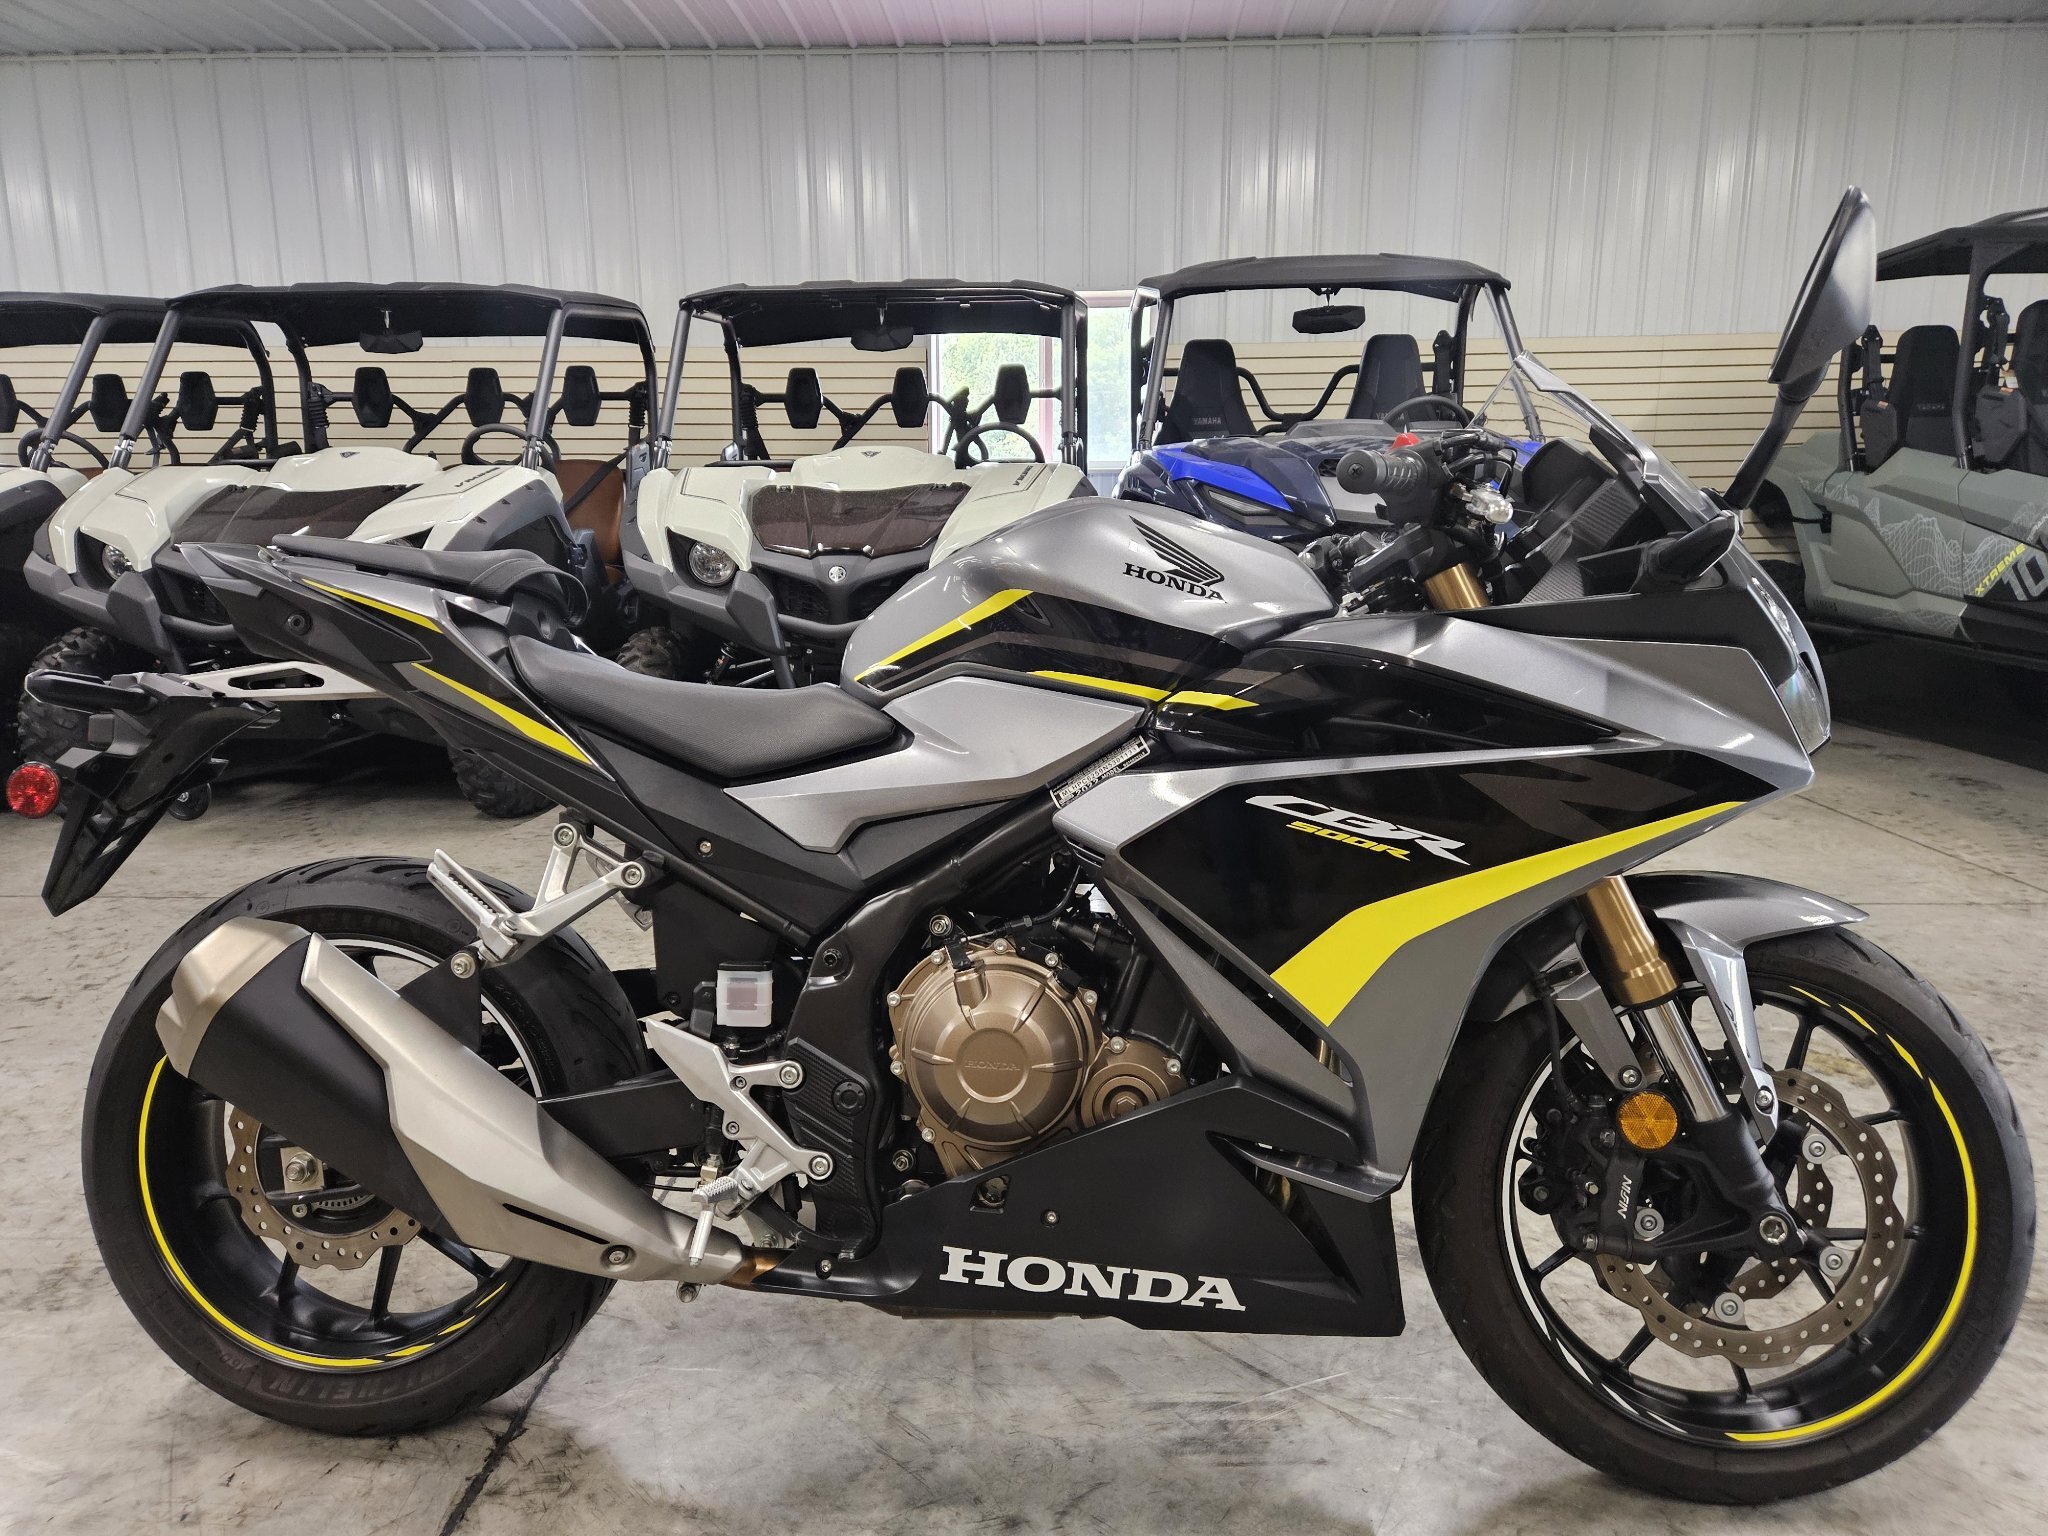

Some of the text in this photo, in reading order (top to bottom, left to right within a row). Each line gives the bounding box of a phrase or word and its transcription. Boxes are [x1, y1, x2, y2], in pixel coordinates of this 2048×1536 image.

[1192, 416, 1222, 425] YAMAHA
[1122, 562, 1228, 604] HONDA
[1075, 766, 1121, 797] 2022 MODEL
[1246, 795, 1471, 866] CBR
[1286, 820, 1411, 862] 500R
[963, 1060, 1021, 1072] HONDA
[939, 1245, 1247, 1312] HONDA
